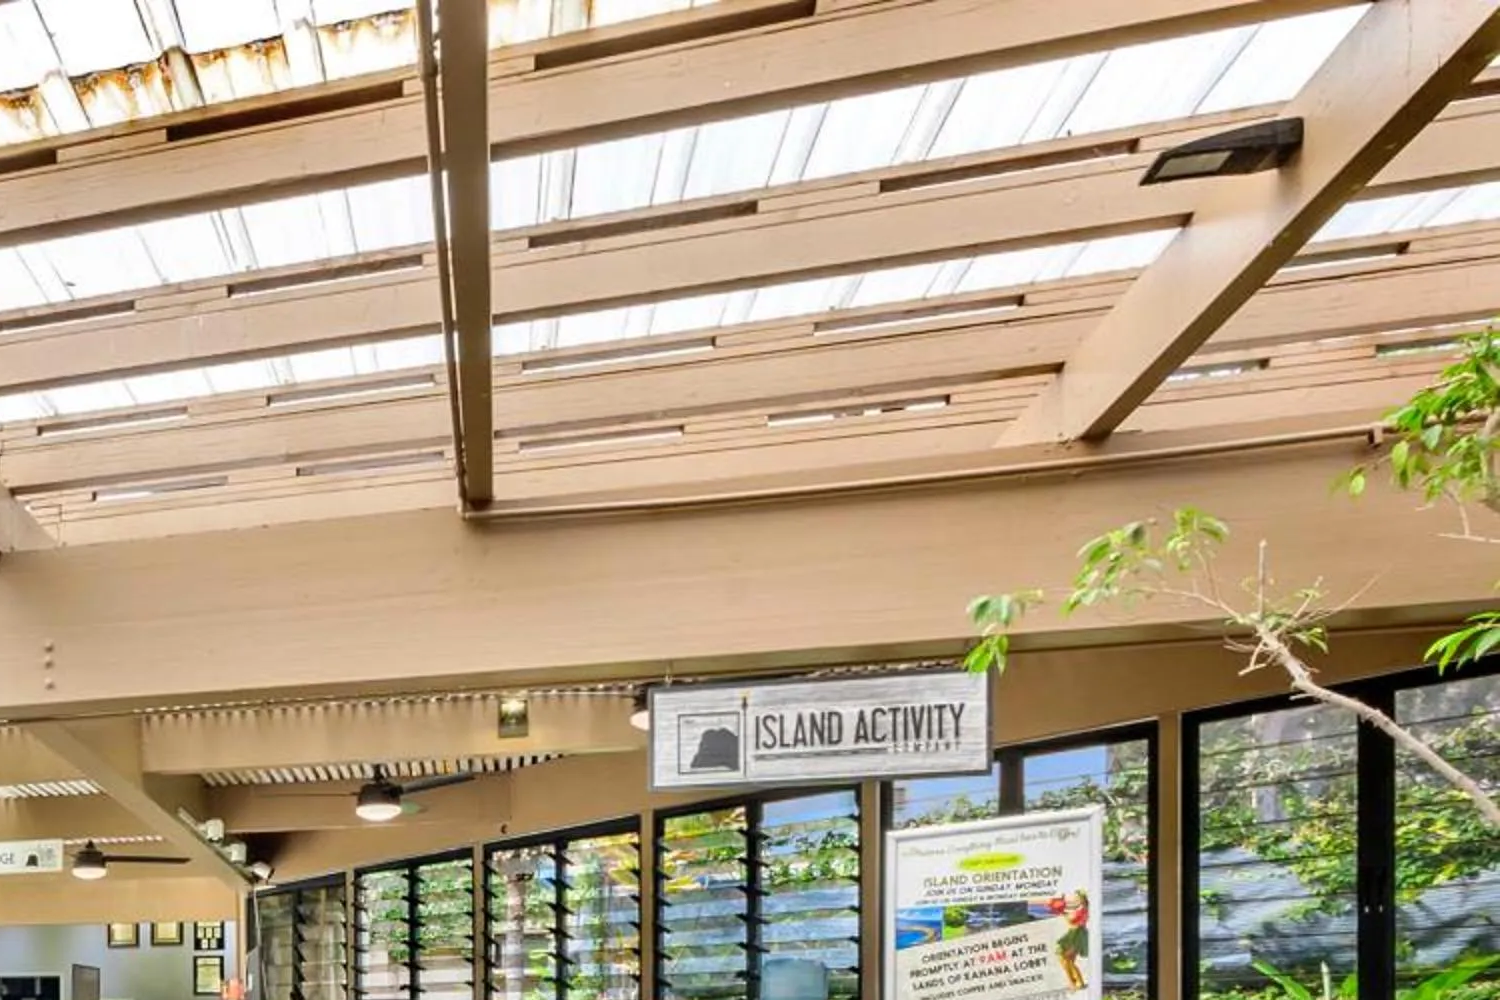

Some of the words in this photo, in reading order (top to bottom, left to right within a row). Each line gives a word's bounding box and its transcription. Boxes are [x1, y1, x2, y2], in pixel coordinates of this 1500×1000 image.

[755, 711, 843, 750] ISLAND
[854, 703, 965, 745] ACTIVITY
[923, 874, 969, 888] ISLAND
[971, 865, 1063, 885] ORIENTATION
[909, 962, 959, 979] PROMPTLY
[963, 958, 975, 968] AT
[1011, 948, 1023, 958] AT
[1027, 943, 1048, 955] THE
[921, 943, 989, 964] ORIENTATION
[992, 934, 1029, 949] BEGINS
[912, 977, 945, 991] LANDS
[947, 974, 961, 985] OF
[963, 965, 1011, 981] KAHANA
[1013, 957, 1048, 973] LOBBY
